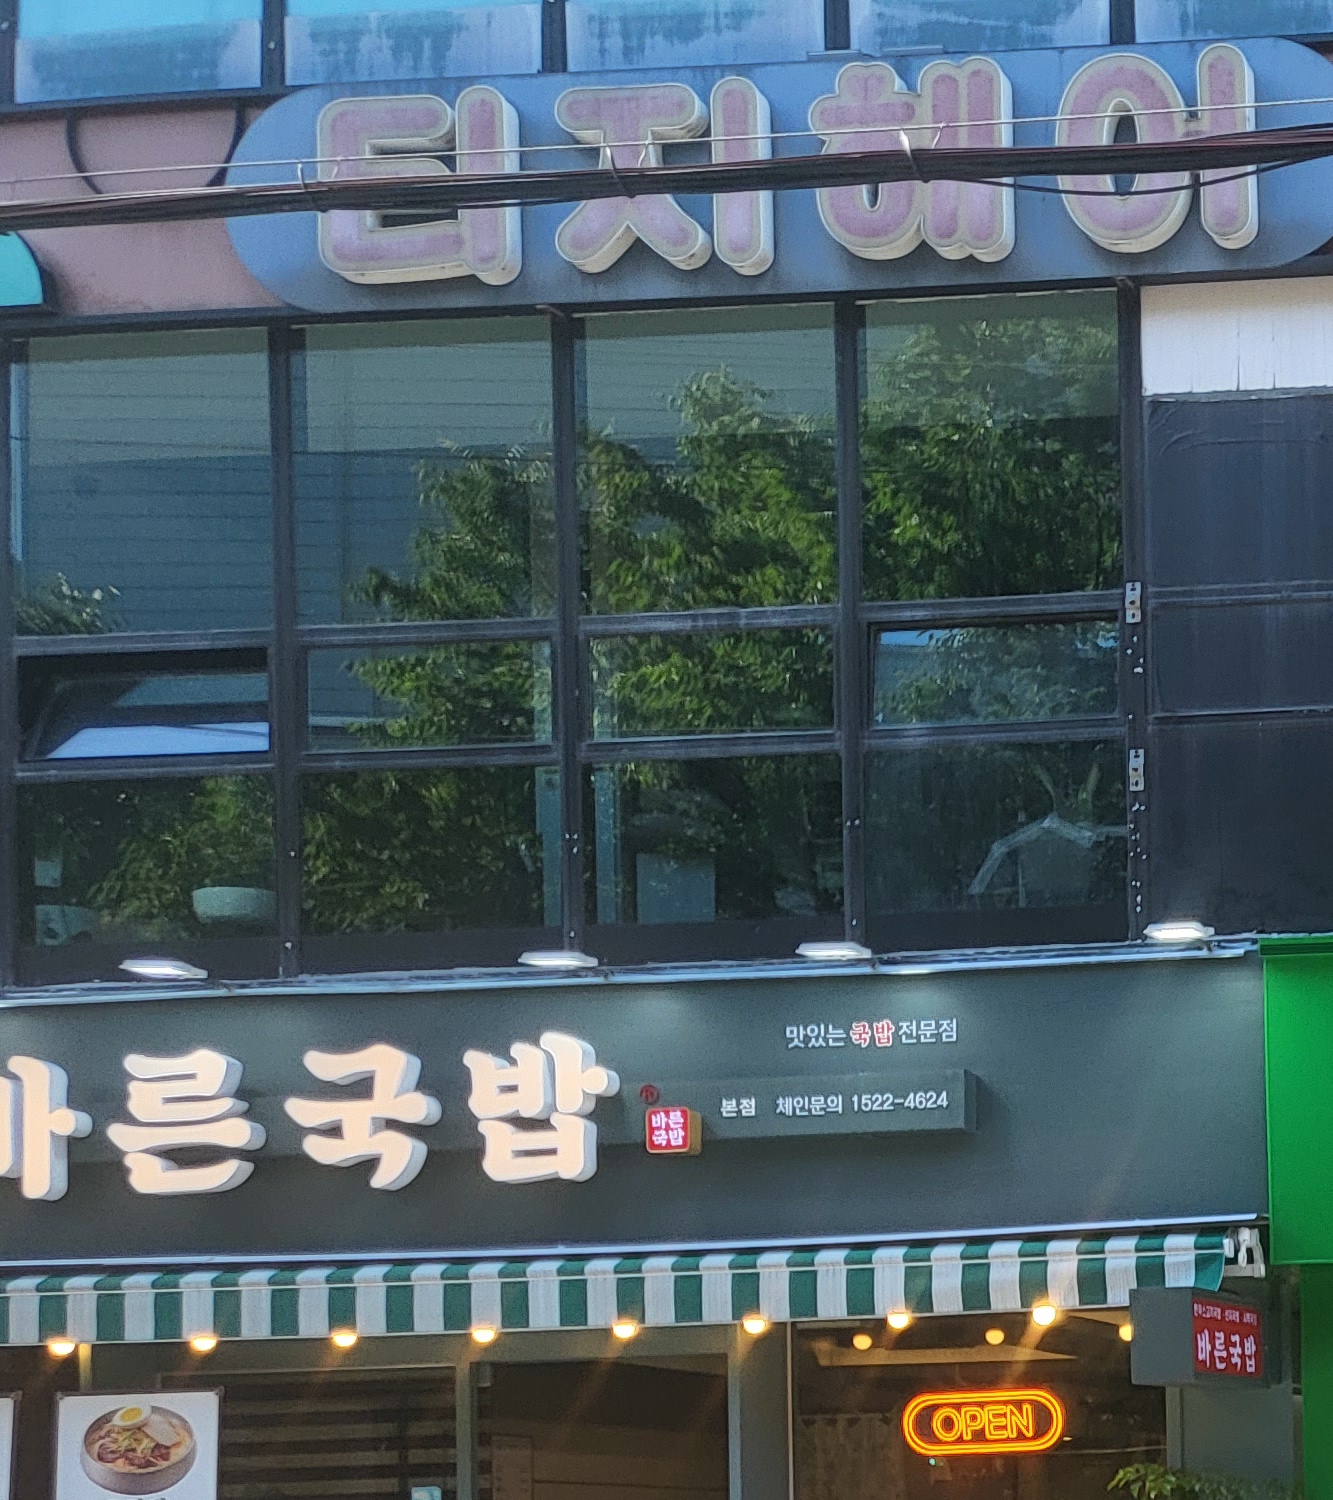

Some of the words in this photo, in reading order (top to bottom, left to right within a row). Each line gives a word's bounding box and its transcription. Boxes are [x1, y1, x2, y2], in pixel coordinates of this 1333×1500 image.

[785, 1023, 847, 1049] 맛있는
[850, 1020, 894, 1048] 국밥
[898, 1018, 958, 1045] 전문점
[651, 1110, 684, 1128] 바른
[720, 1097, 757, 1118] 본점
[776, 1095, 843, 1117] 체인문의
[852, 1090, 949, 1113] 1522-4624
[1196, 1328, 1257, 1373] 바른국밥
[932, 1402, 1035, 1444] OPEN
